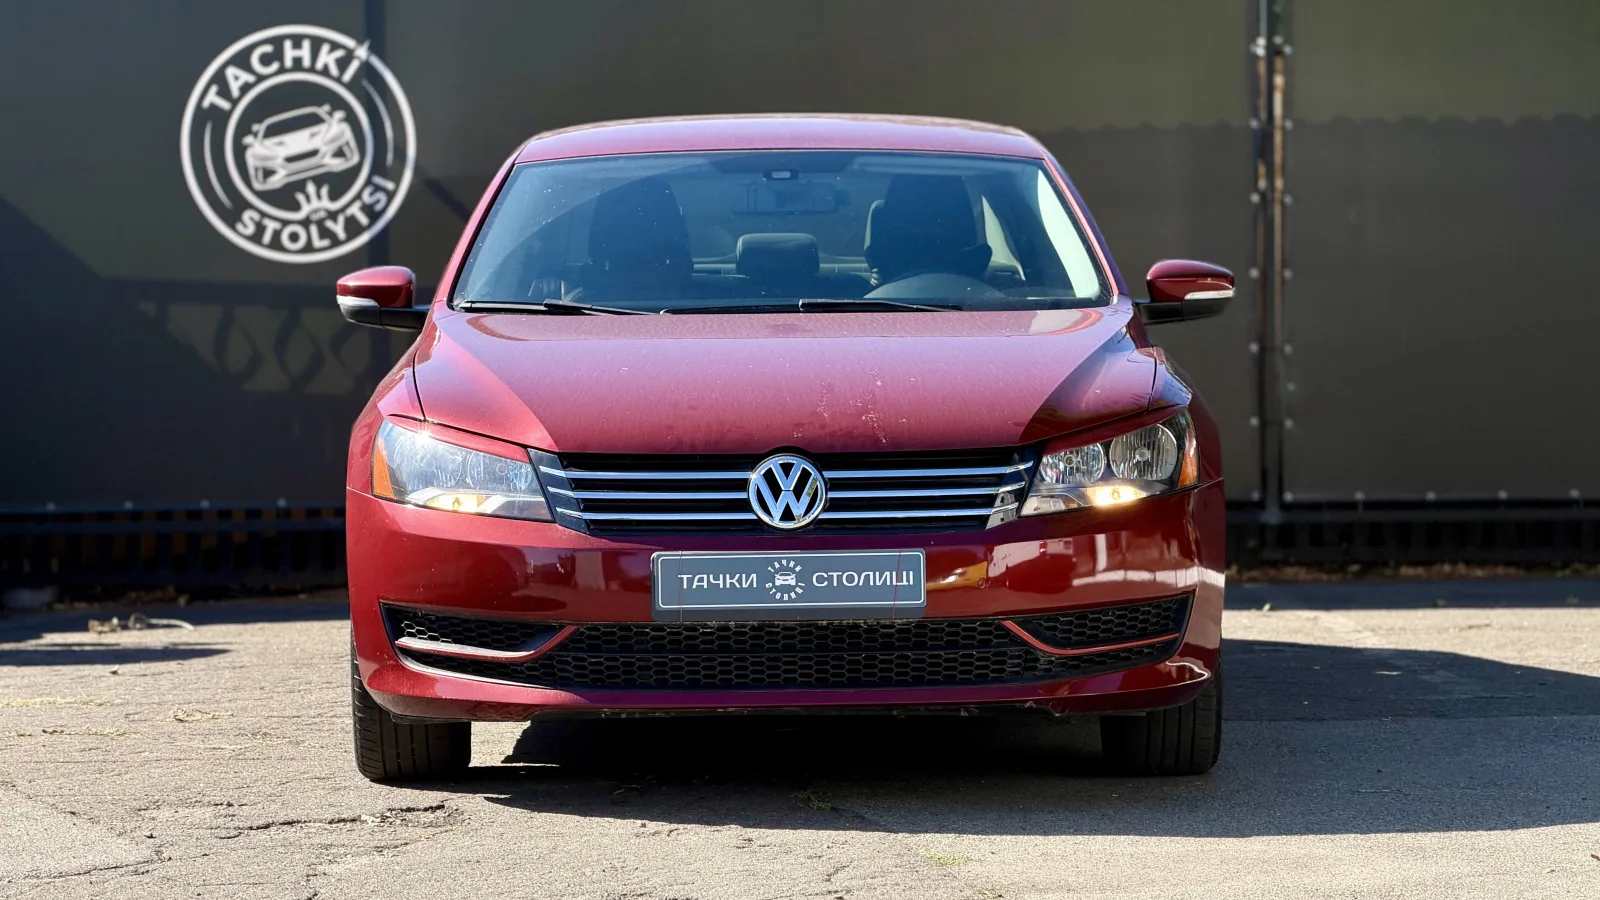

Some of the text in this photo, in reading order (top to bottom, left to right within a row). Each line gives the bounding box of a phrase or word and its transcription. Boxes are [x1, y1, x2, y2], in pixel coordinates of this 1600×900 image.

[750, 455, 825, 527] VW
[767, 559, 802, 573] ТАЧКИ
[678, 573, 757, 589] ТАЧКИ
